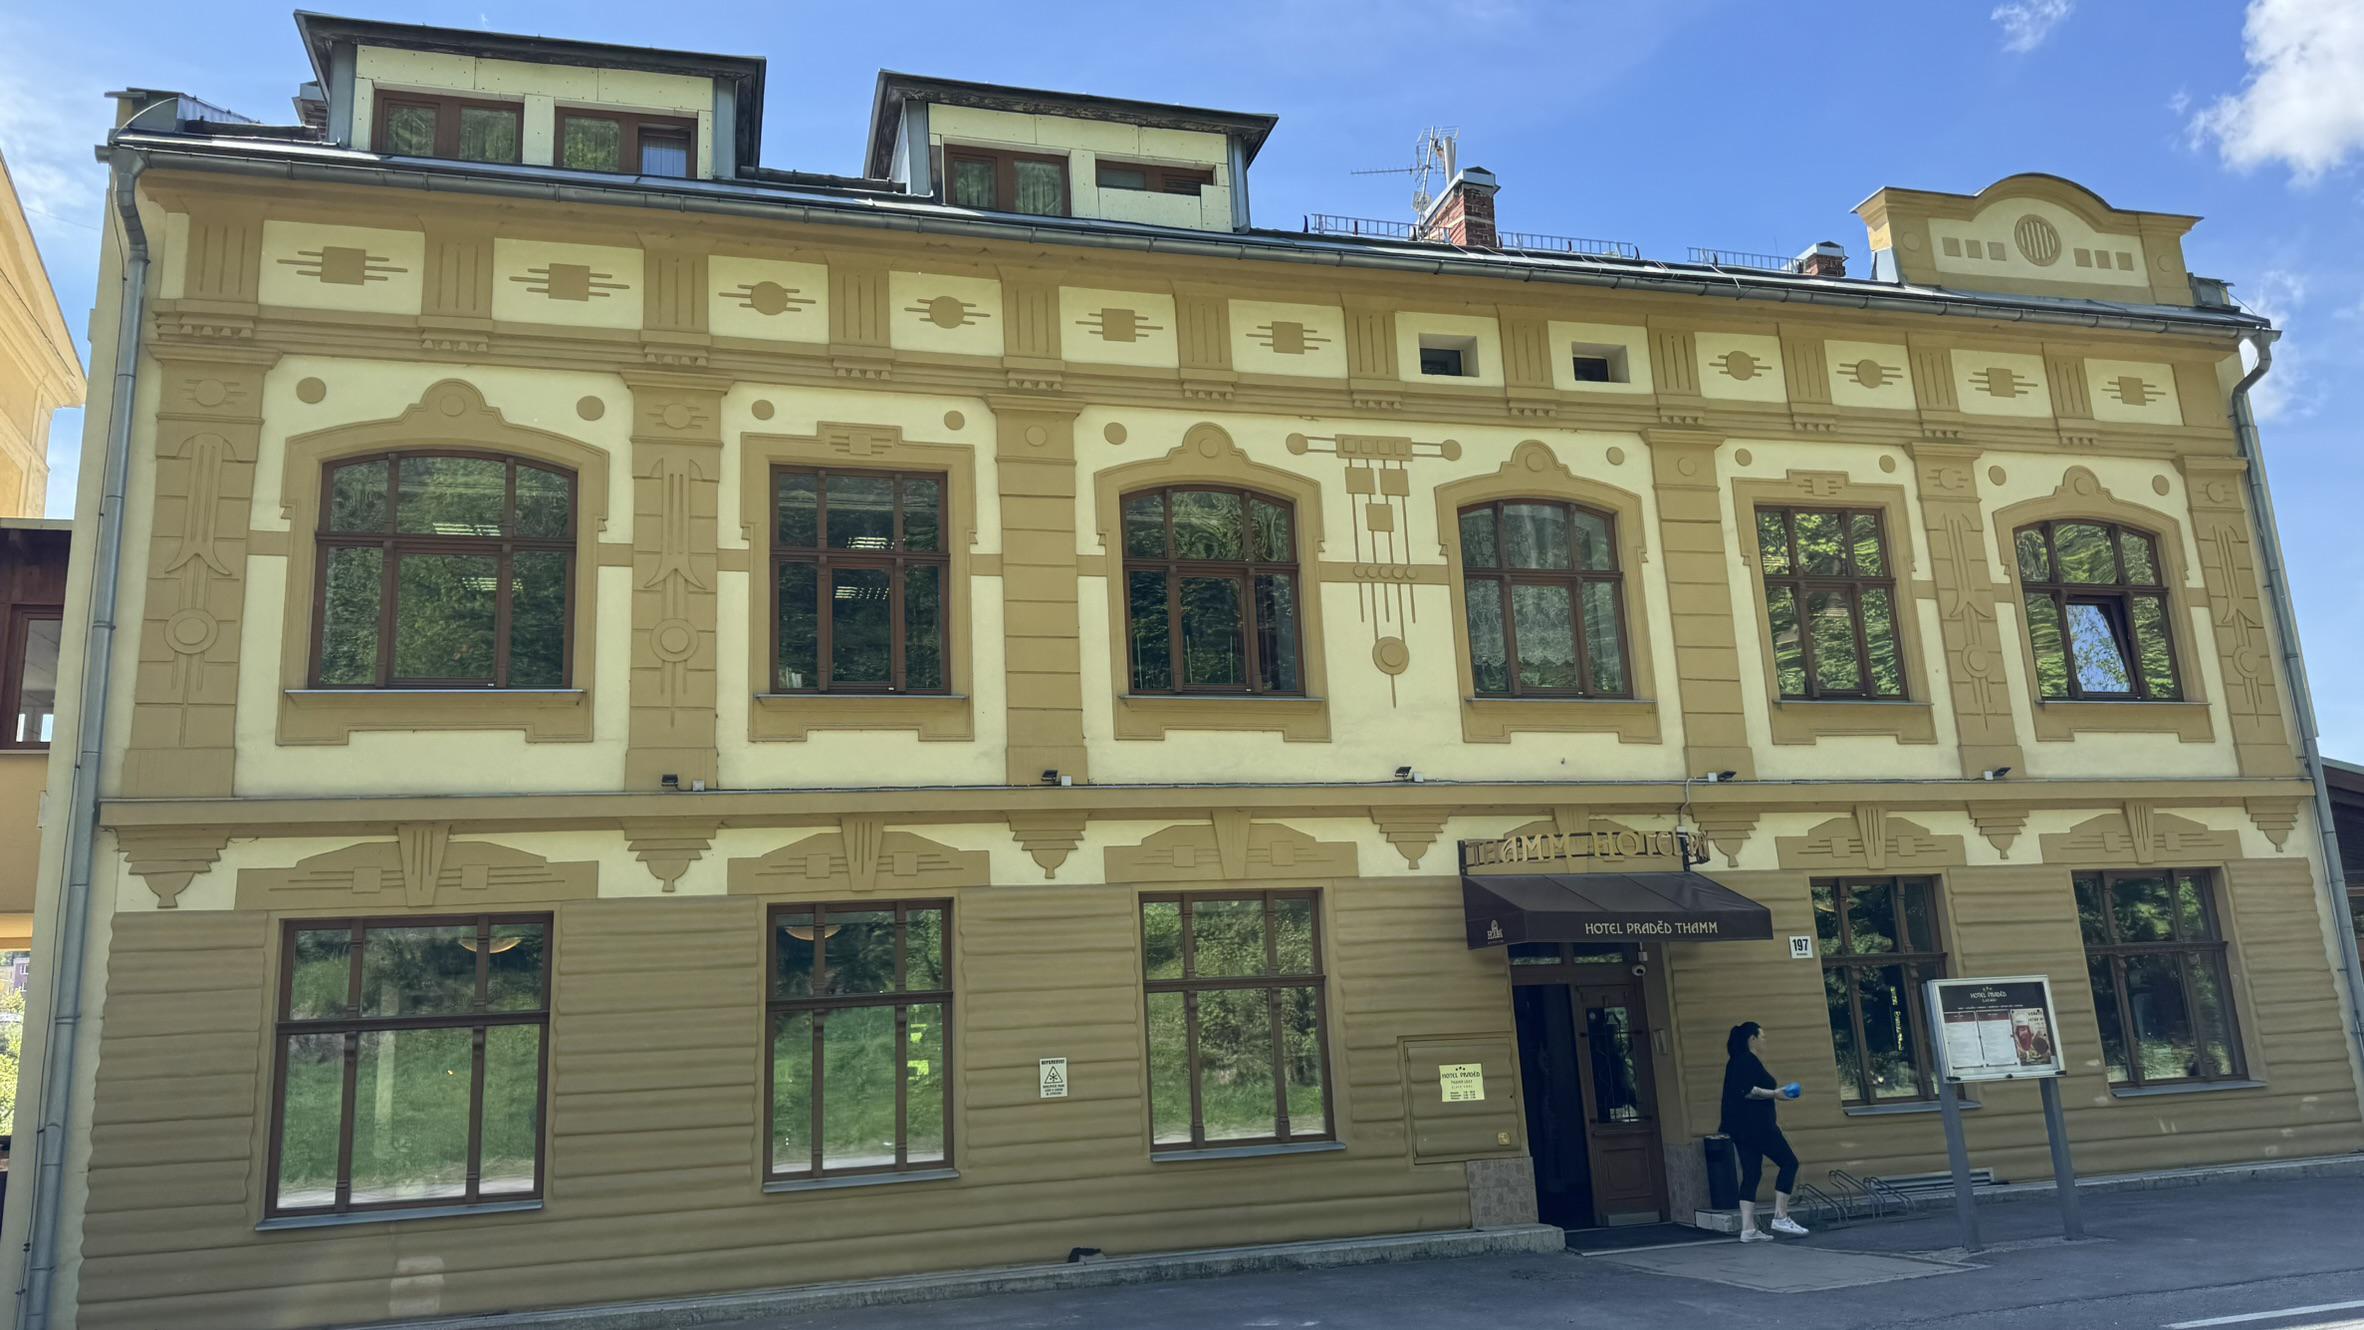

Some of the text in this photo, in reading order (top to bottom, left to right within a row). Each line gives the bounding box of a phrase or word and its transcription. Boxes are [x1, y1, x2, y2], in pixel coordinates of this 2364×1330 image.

[1585, 920, 1719, 935] HOTEL PRADĚD THAMM
[1791, 938, 1808, 952] 197
